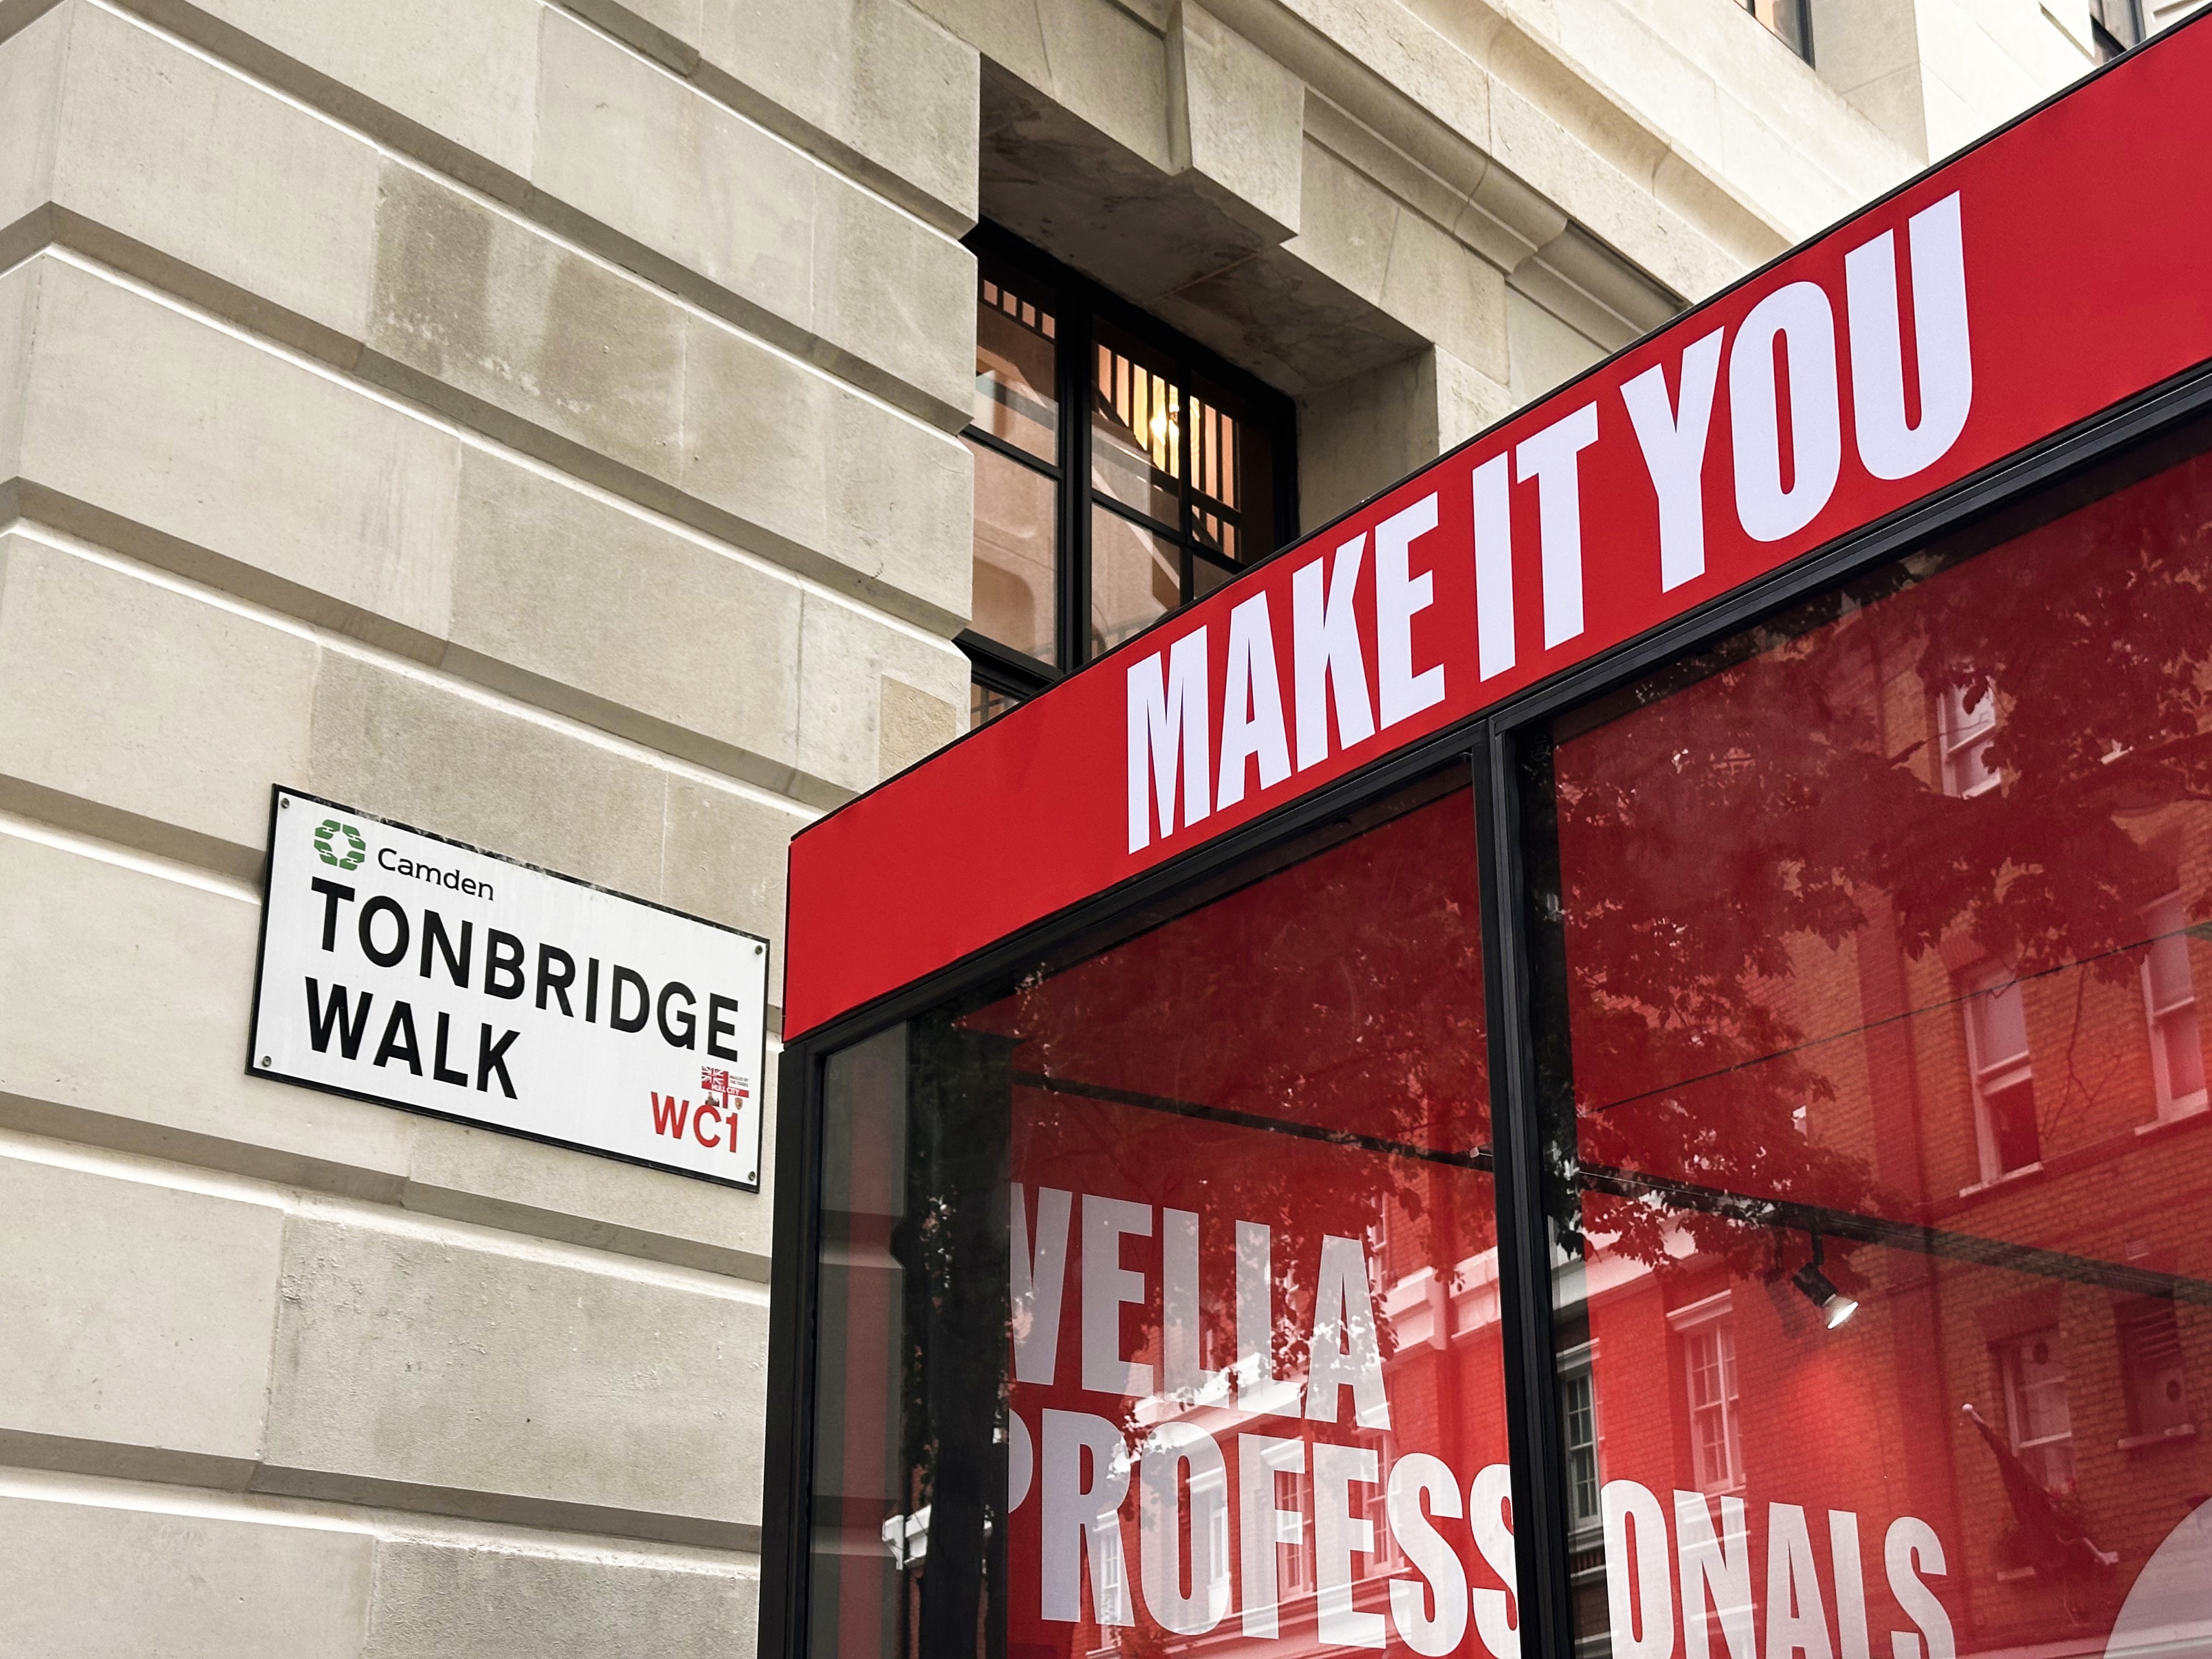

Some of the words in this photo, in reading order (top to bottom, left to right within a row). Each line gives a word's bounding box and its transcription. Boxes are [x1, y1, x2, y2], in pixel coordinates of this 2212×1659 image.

[1127, 491, 1446, 855] MAKE
[1472, 400, 1599, 683] IT
[1619, 190, 1973, 594] YOU
[377, 848, 493, 901] Camden
[311, 876, 739, 1062] TONBRIDGE
[304, 976, 521, 1100] WALK
[712, 1083, 726, 1093] HULL
[726, 1087, 740, 1095] CITY
[651, 1091, 738, 1153] WC1
[1008, 1408, 1957, 1659] ROFESSONALS
